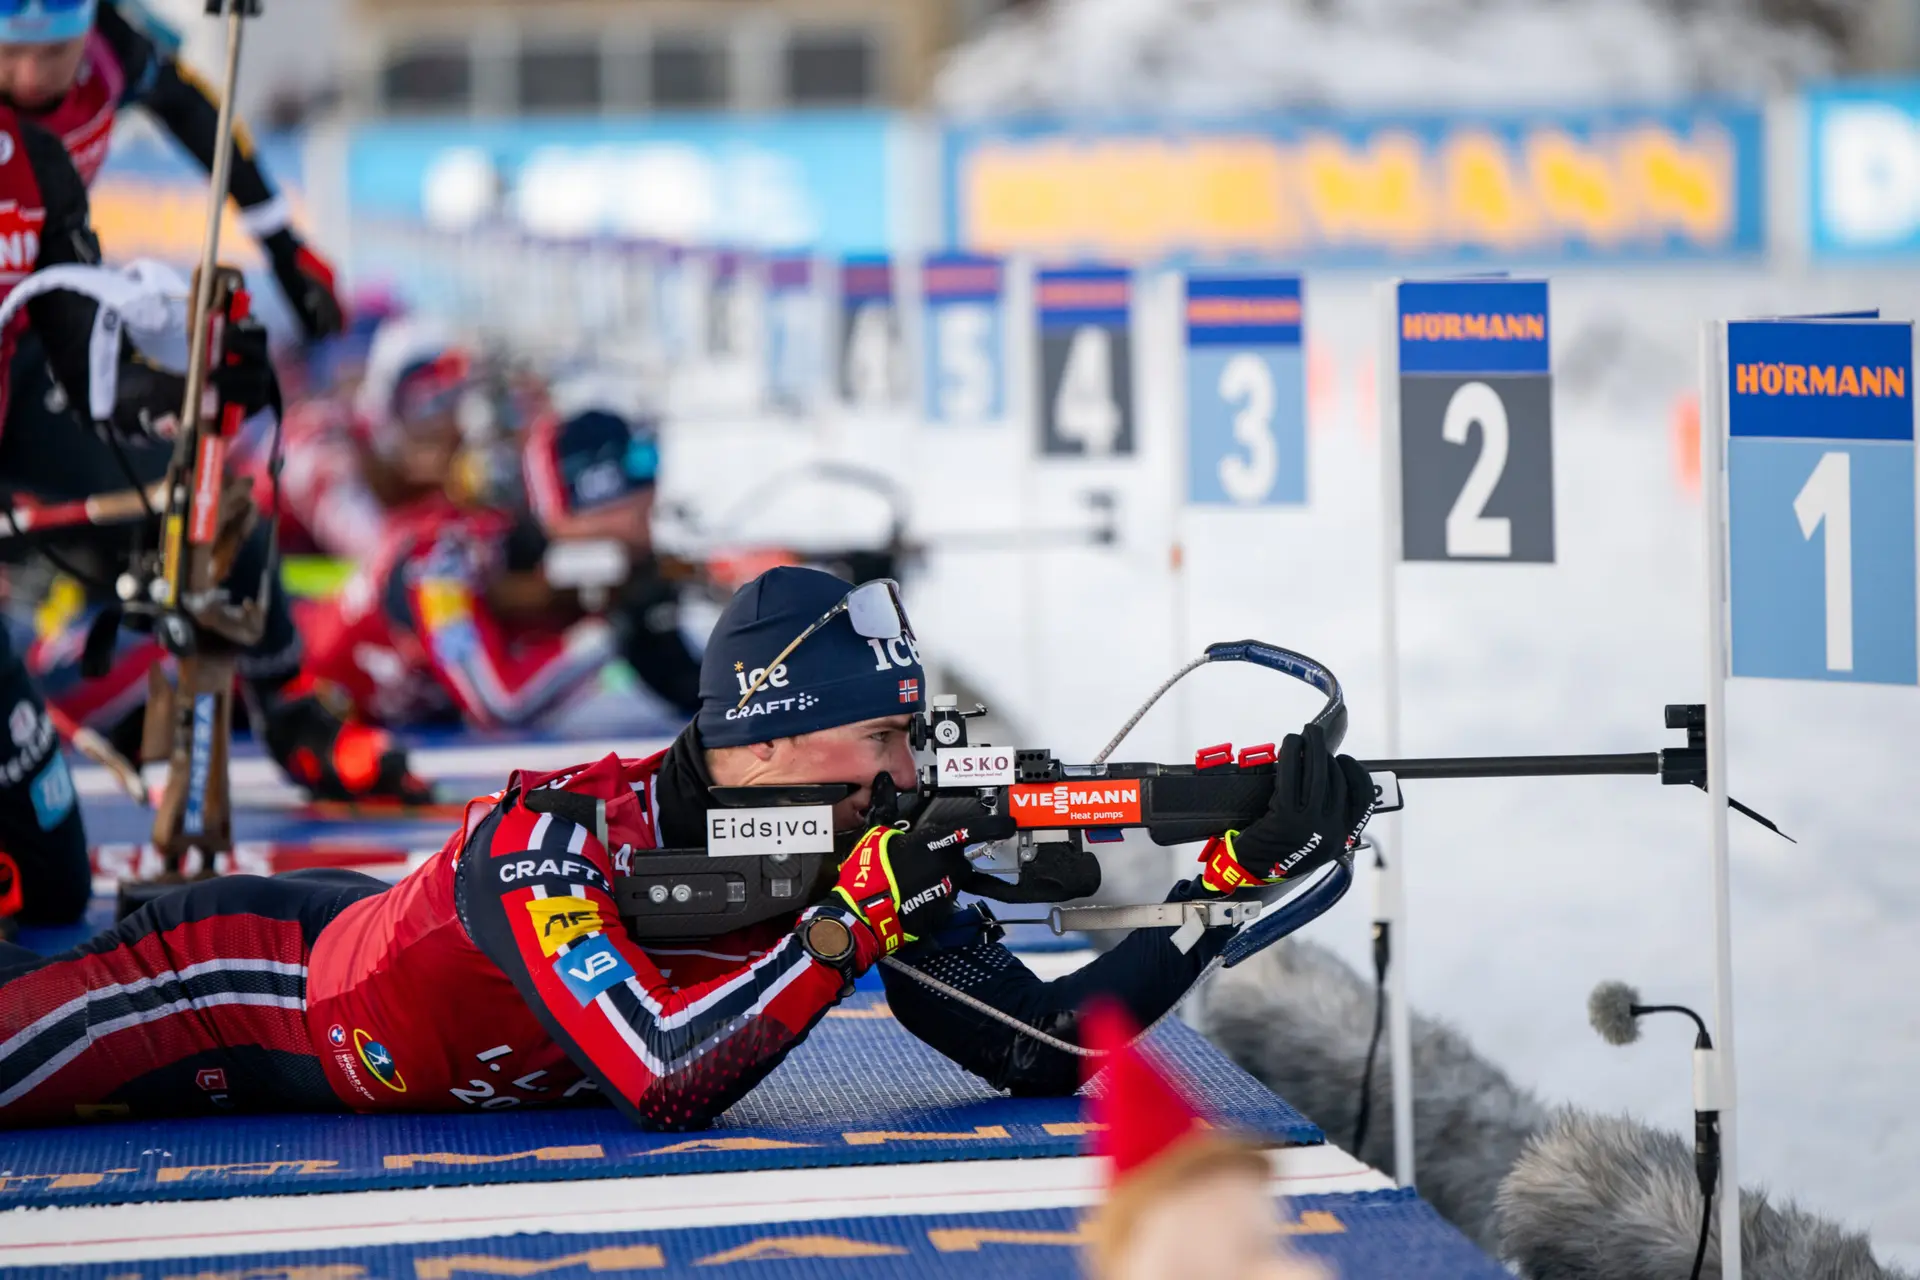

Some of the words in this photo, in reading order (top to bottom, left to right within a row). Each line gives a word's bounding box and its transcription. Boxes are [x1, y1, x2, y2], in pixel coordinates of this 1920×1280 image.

[1402, 312, 1545, 341] HÖRMANN
[1055, 322, 1122, 456] 4
[1736, 361, 1905, 398] HÖRMANN
[1217, 353, 1278, 502] 3
[1442, 381, 1511, 558] 2
[1793, 452, 1853, 671] 1
[734, 661, 789, 695] ice
[725, 698, 796, 720] CRAFT
[945, 756, 1009, 772] ASKO
[1013, 786, 1137, 814] VIESSMANN
[1070, 811, 1091, 820] Heat
[1093, 811, 1124, 821] pumps
[500, 859, 600, 883] CRAFT
[880, 916, 900, 954] LE
[568, 951, 618, 982] VB
